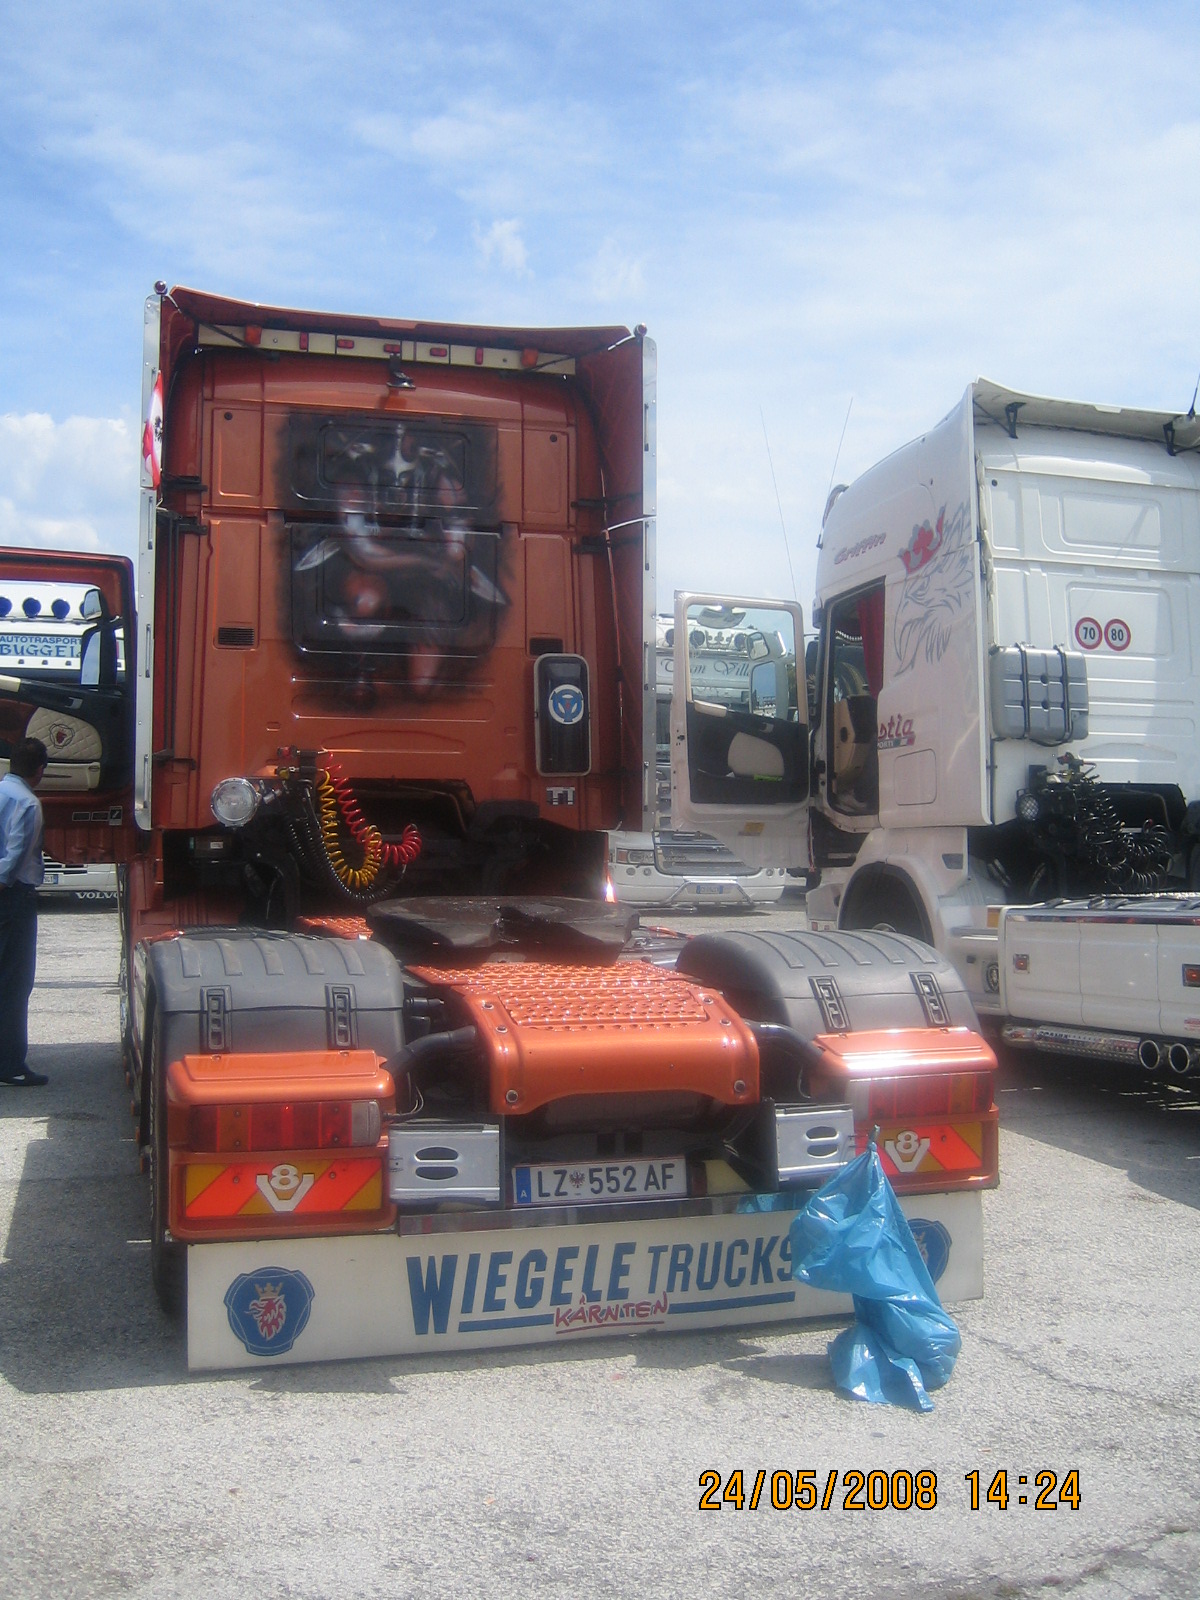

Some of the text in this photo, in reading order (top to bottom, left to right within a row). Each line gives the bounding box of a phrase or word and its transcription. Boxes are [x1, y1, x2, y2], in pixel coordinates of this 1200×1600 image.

[1083, 627, 1096, 640] 70
[1111, 628, 1124, 642] 80
[520, 1163, 675, 1198] A LZ 552 AF
[405, 1235, 793, 1335] WIEGELE TRUCKS
